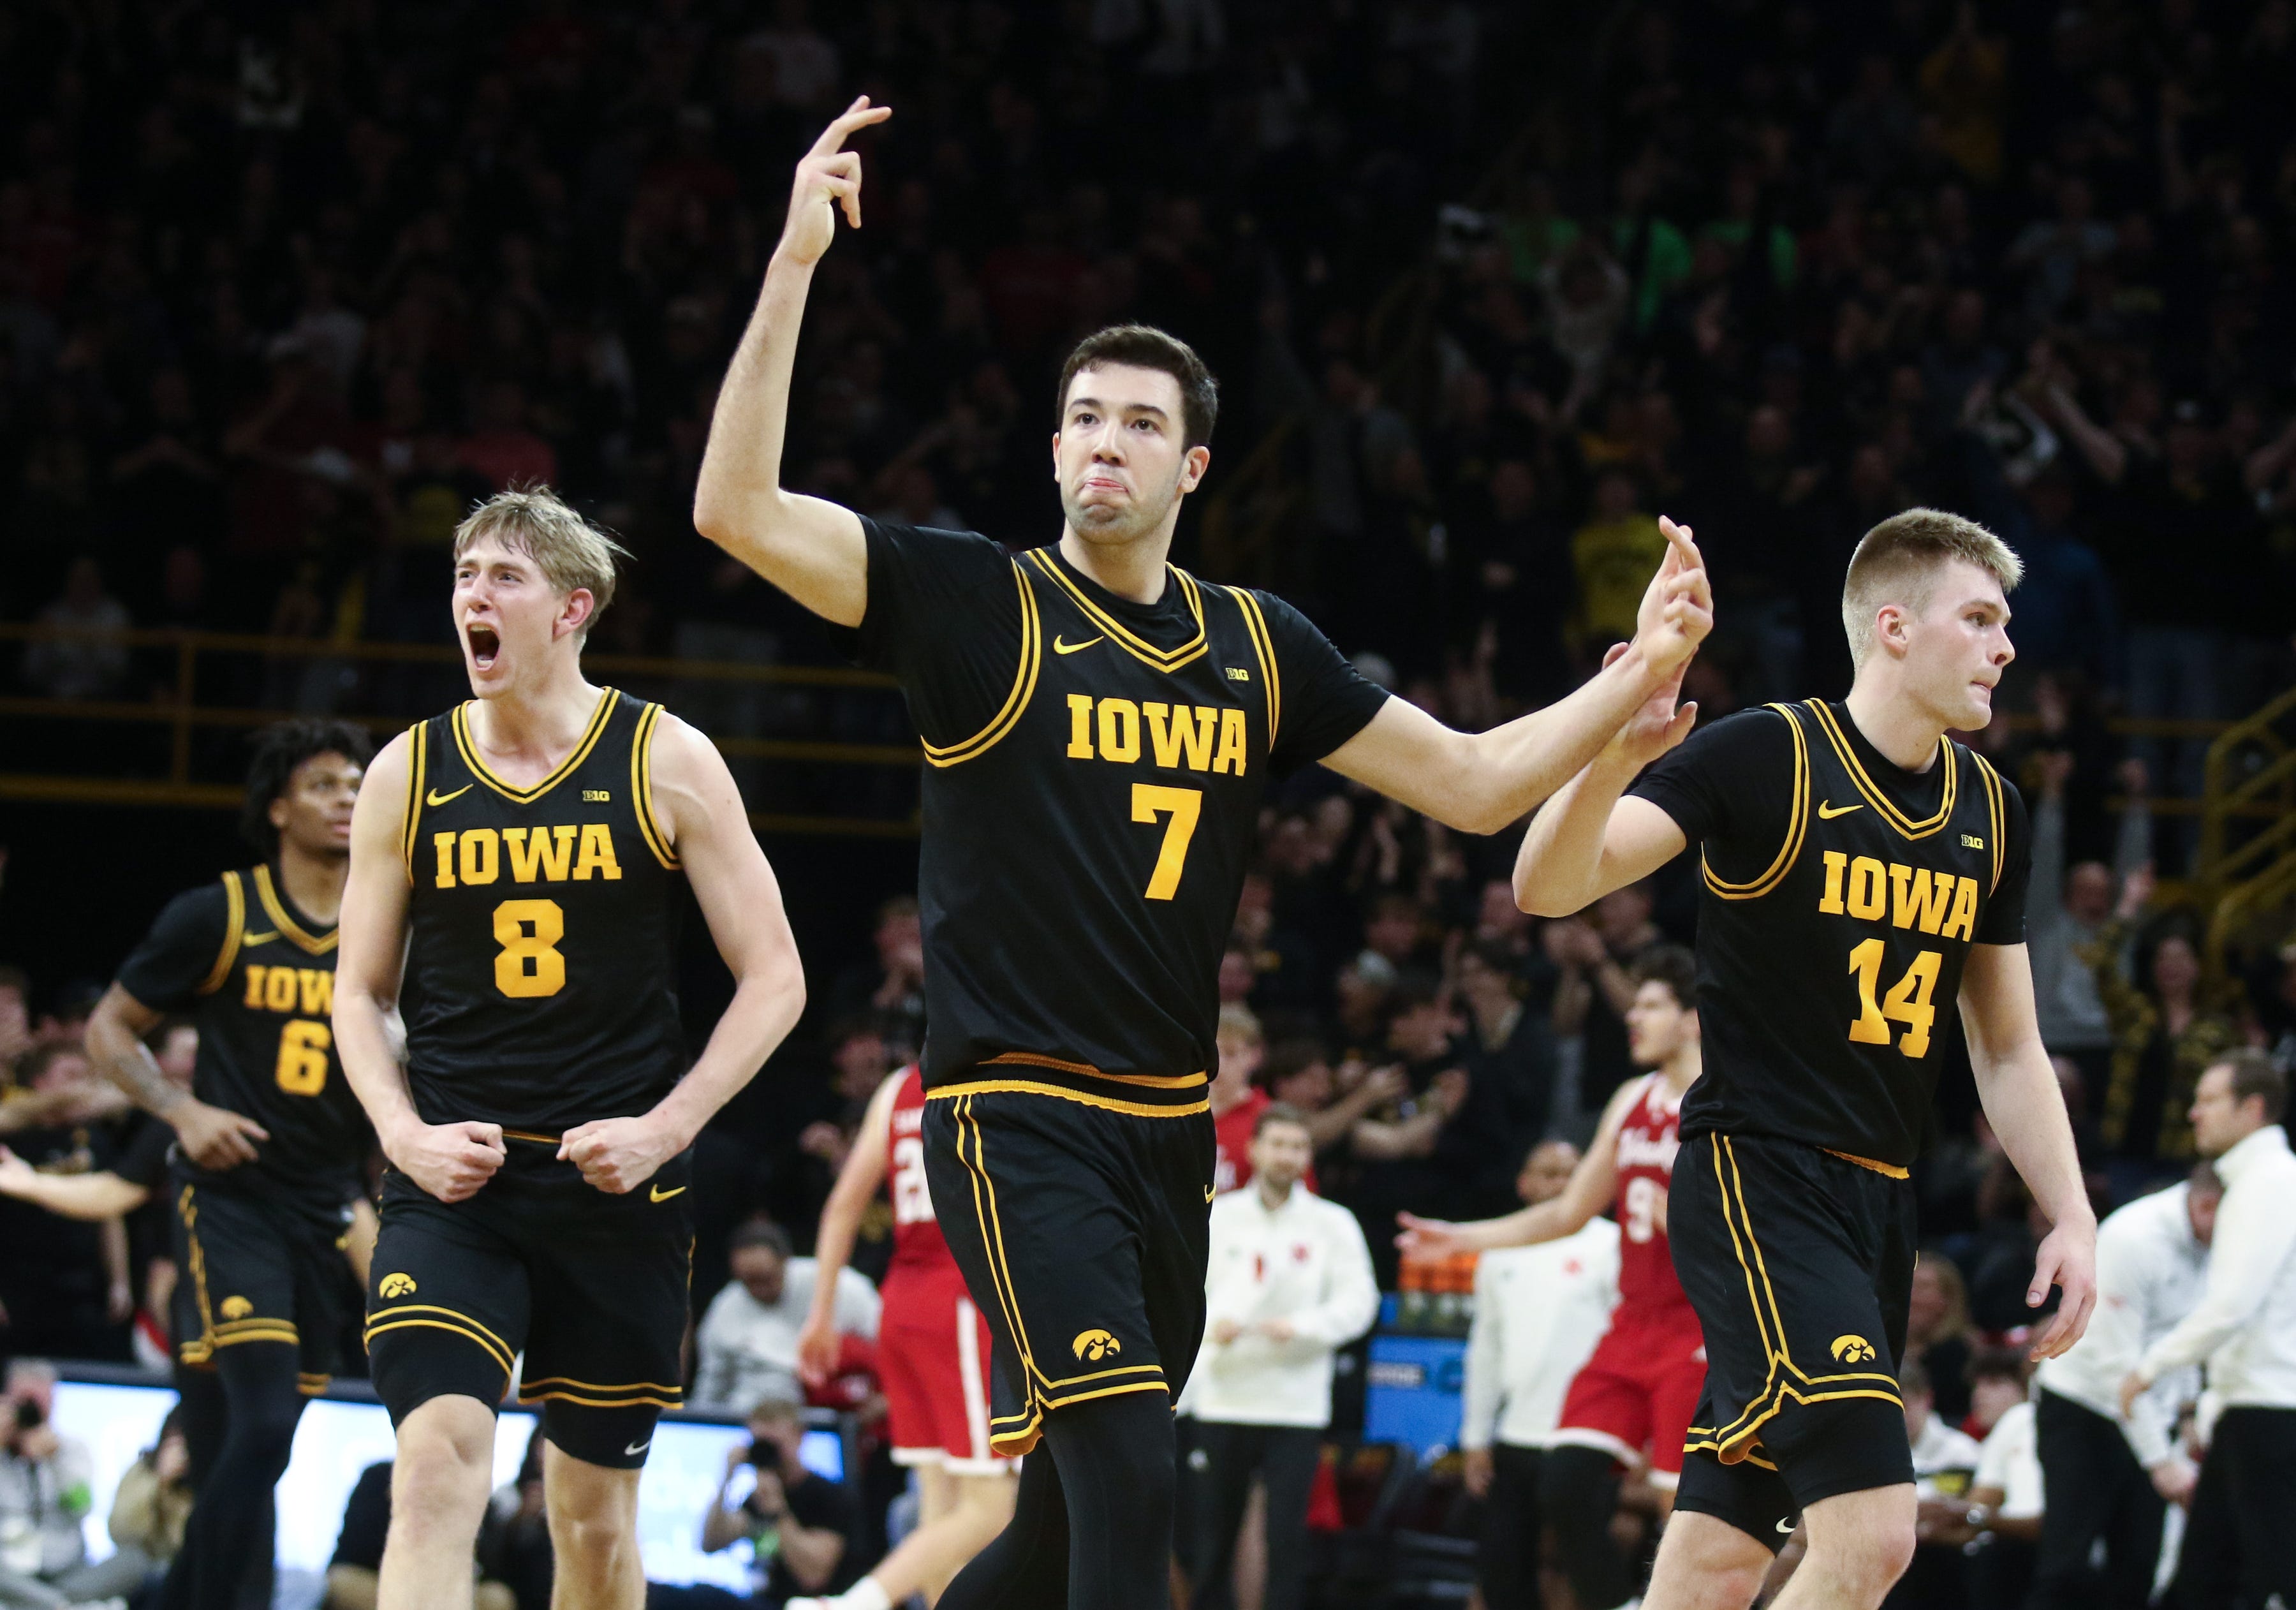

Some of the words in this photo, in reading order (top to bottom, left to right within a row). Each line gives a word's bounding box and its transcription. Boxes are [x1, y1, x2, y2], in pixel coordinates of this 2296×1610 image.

[1068, 694, 1247, 776] IOWA
[434, 823, 622, 889] IOWA
[1131, 783, 1203, 901] 7
[1818, 851, 1978, 942] IOWA
[244, 964, 337, 1016] IOW
[492, 899, 566, 998] 8
[1848, 938, 1943, 1058] 14
[276, 1019, 332, 1097] 6
[894, 1137, 936, 1225] 2
